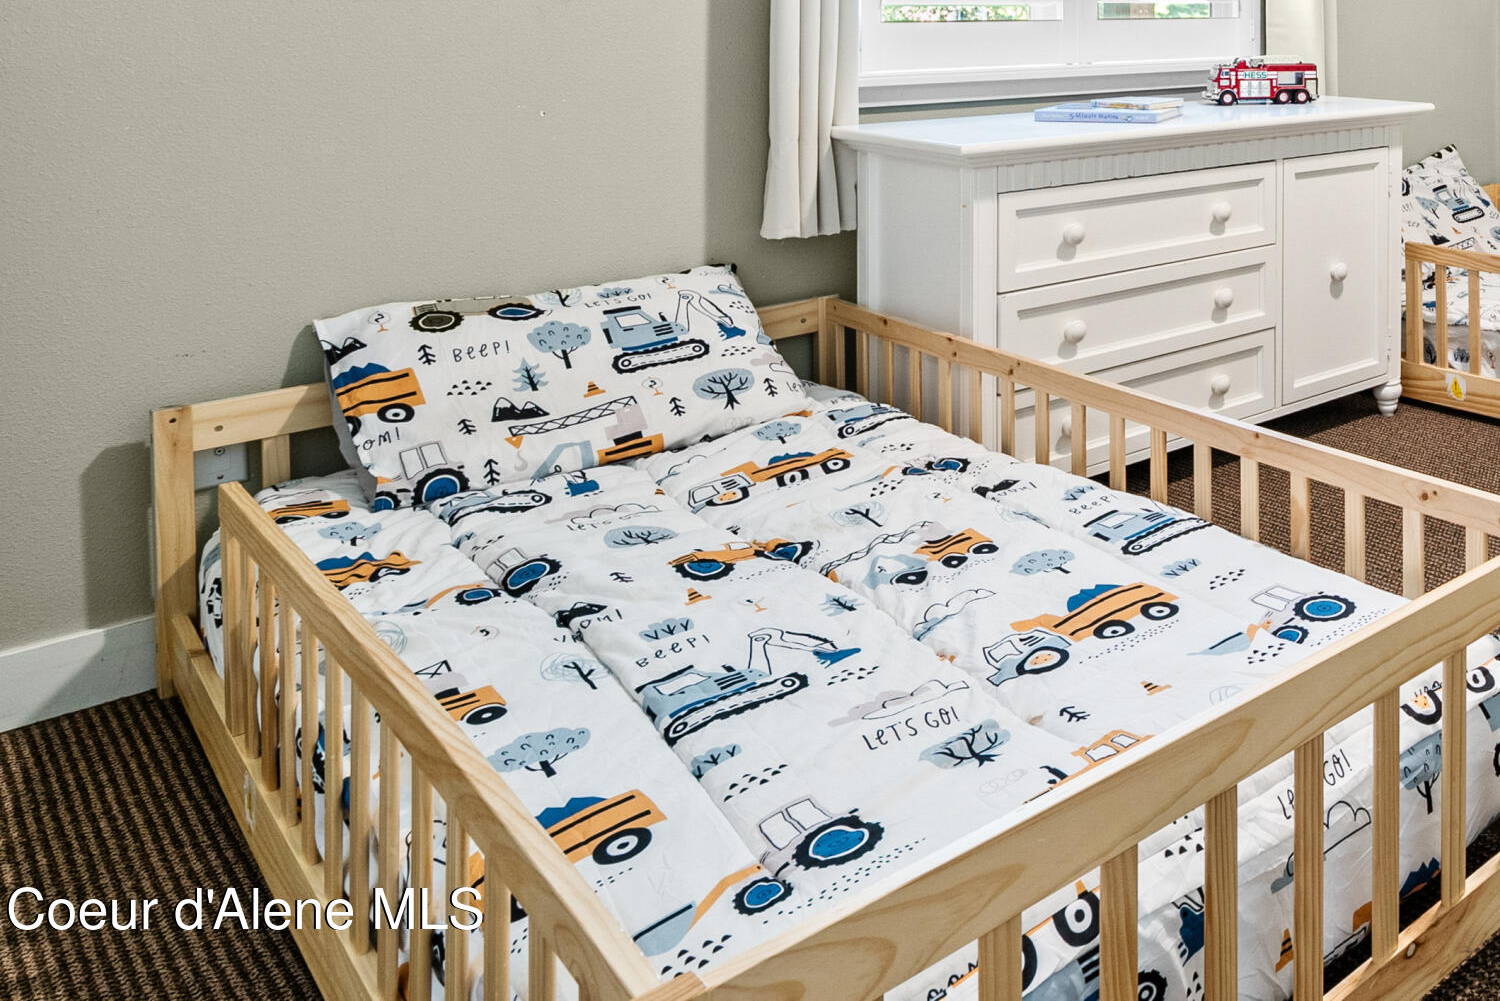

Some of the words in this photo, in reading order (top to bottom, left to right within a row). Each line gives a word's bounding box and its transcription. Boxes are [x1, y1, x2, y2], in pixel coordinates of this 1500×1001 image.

[1244, 70, 1267, 79] HESS
[924, 706, 960, 728] GO!
[1323, 748, 1353, 786] GO!
